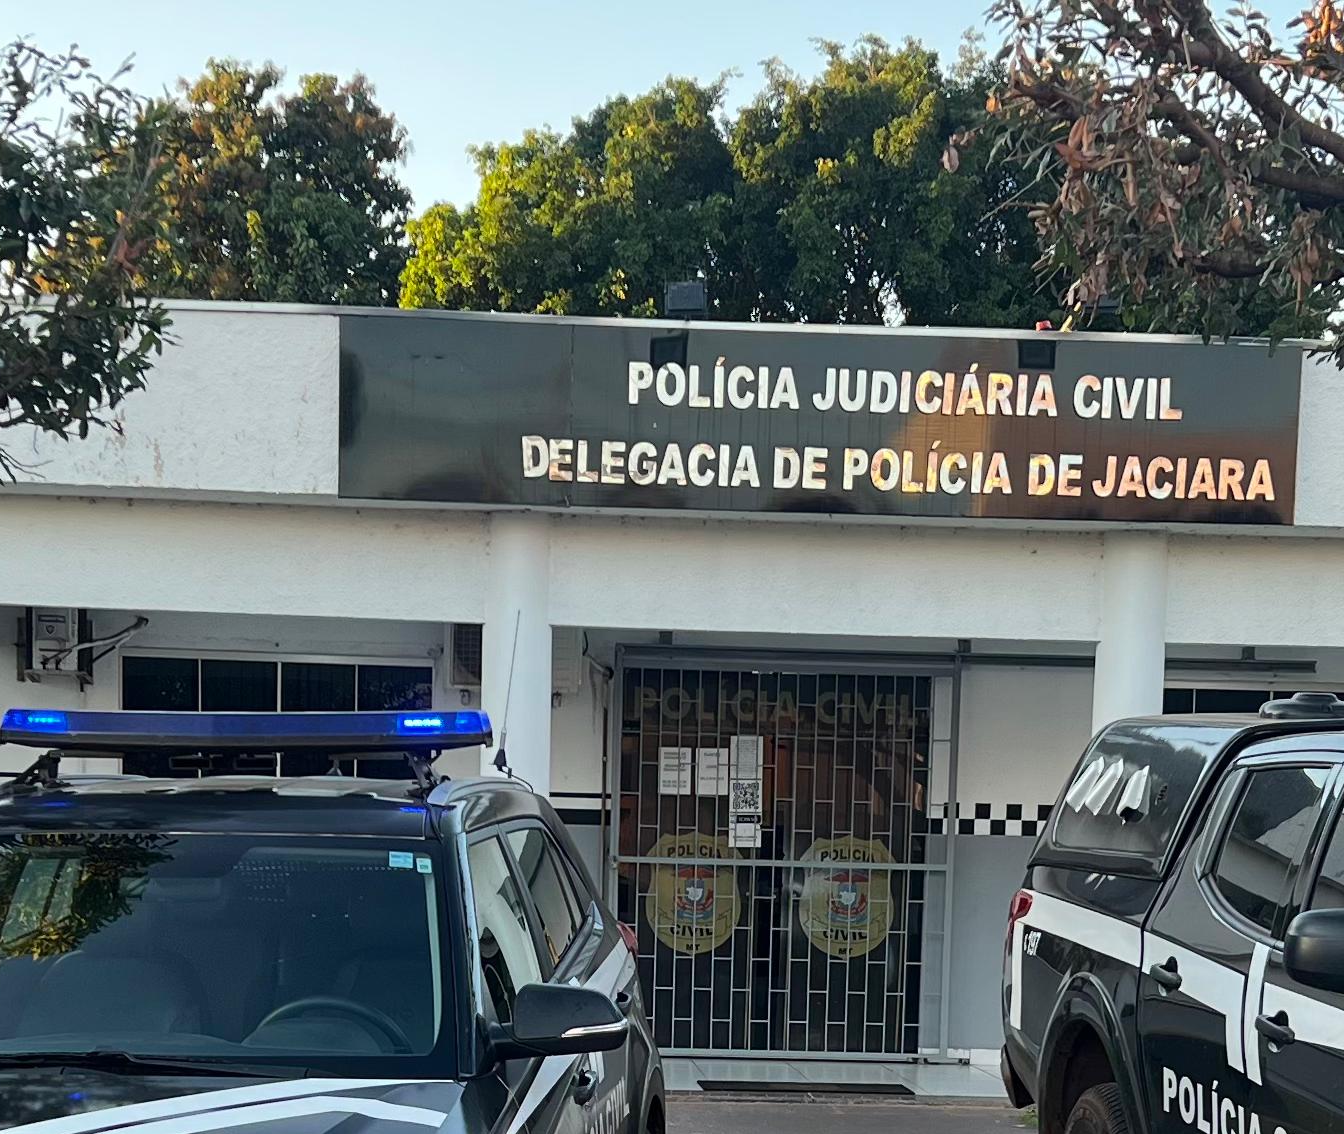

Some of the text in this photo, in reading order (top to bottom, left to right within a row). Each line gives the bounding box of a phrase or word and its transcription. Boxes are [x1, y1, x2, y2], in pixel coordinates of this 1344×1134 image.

[628, 356, 1183, 421] POLÍCIA JUDICIÁRIA CIVIL
[521, 435, 1276, 501] DELEGACIA DE POLÍCIA DE JACIARA
[816, 691, 919, 727] CIVIL
